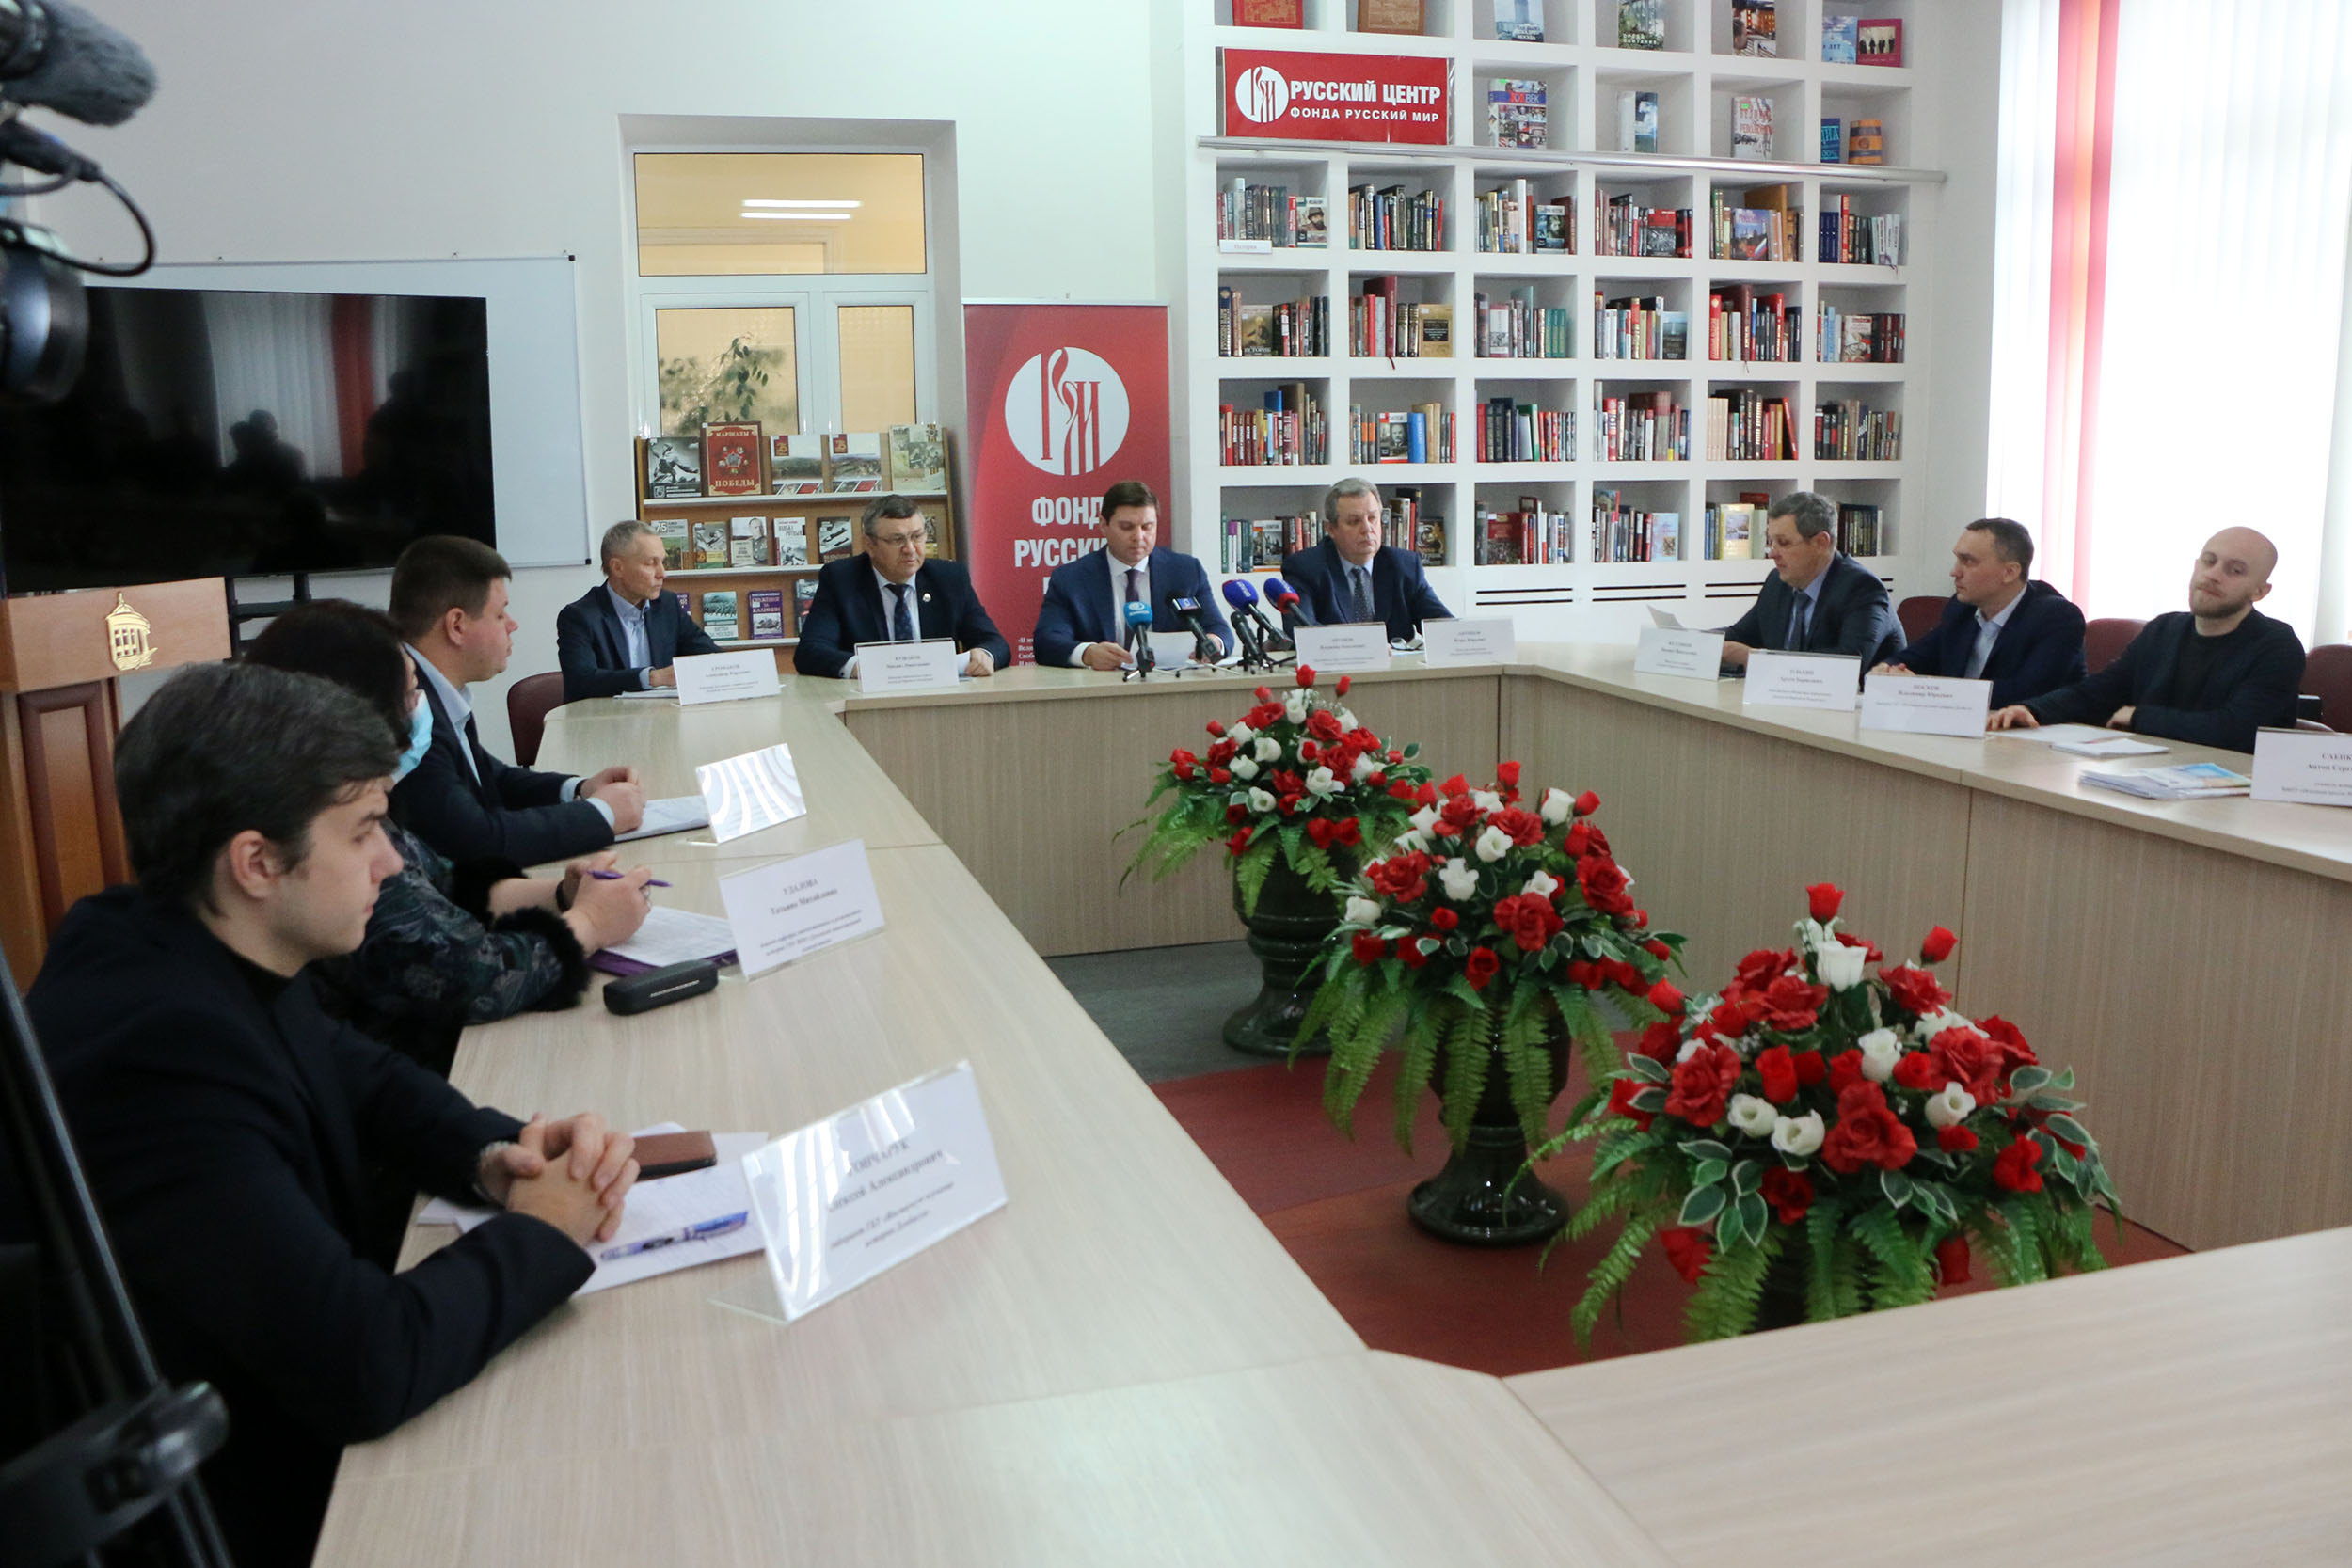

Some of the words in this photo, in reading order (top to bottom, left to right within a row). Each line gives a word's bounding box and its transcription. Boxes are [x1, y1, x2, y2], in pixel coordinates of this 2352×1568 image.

[1290, 80, 1377, 103] РУССКИЙ
[1383, 84, 1441, 106] ЦЕНТР
[1290, 106, 1340, 119] ФОНДА
[1345, 108, 1407, 121] РУССКИЙ
[1412, 111, 1439, 123] МИР
[715, 479, 755, 487] ПОБЕДЫ
[1032, 495, 1104, 530] ФОНД
[1014, 537, 1108, 568] РУССК
[2321, 752, 2352, 761] САЕНК
